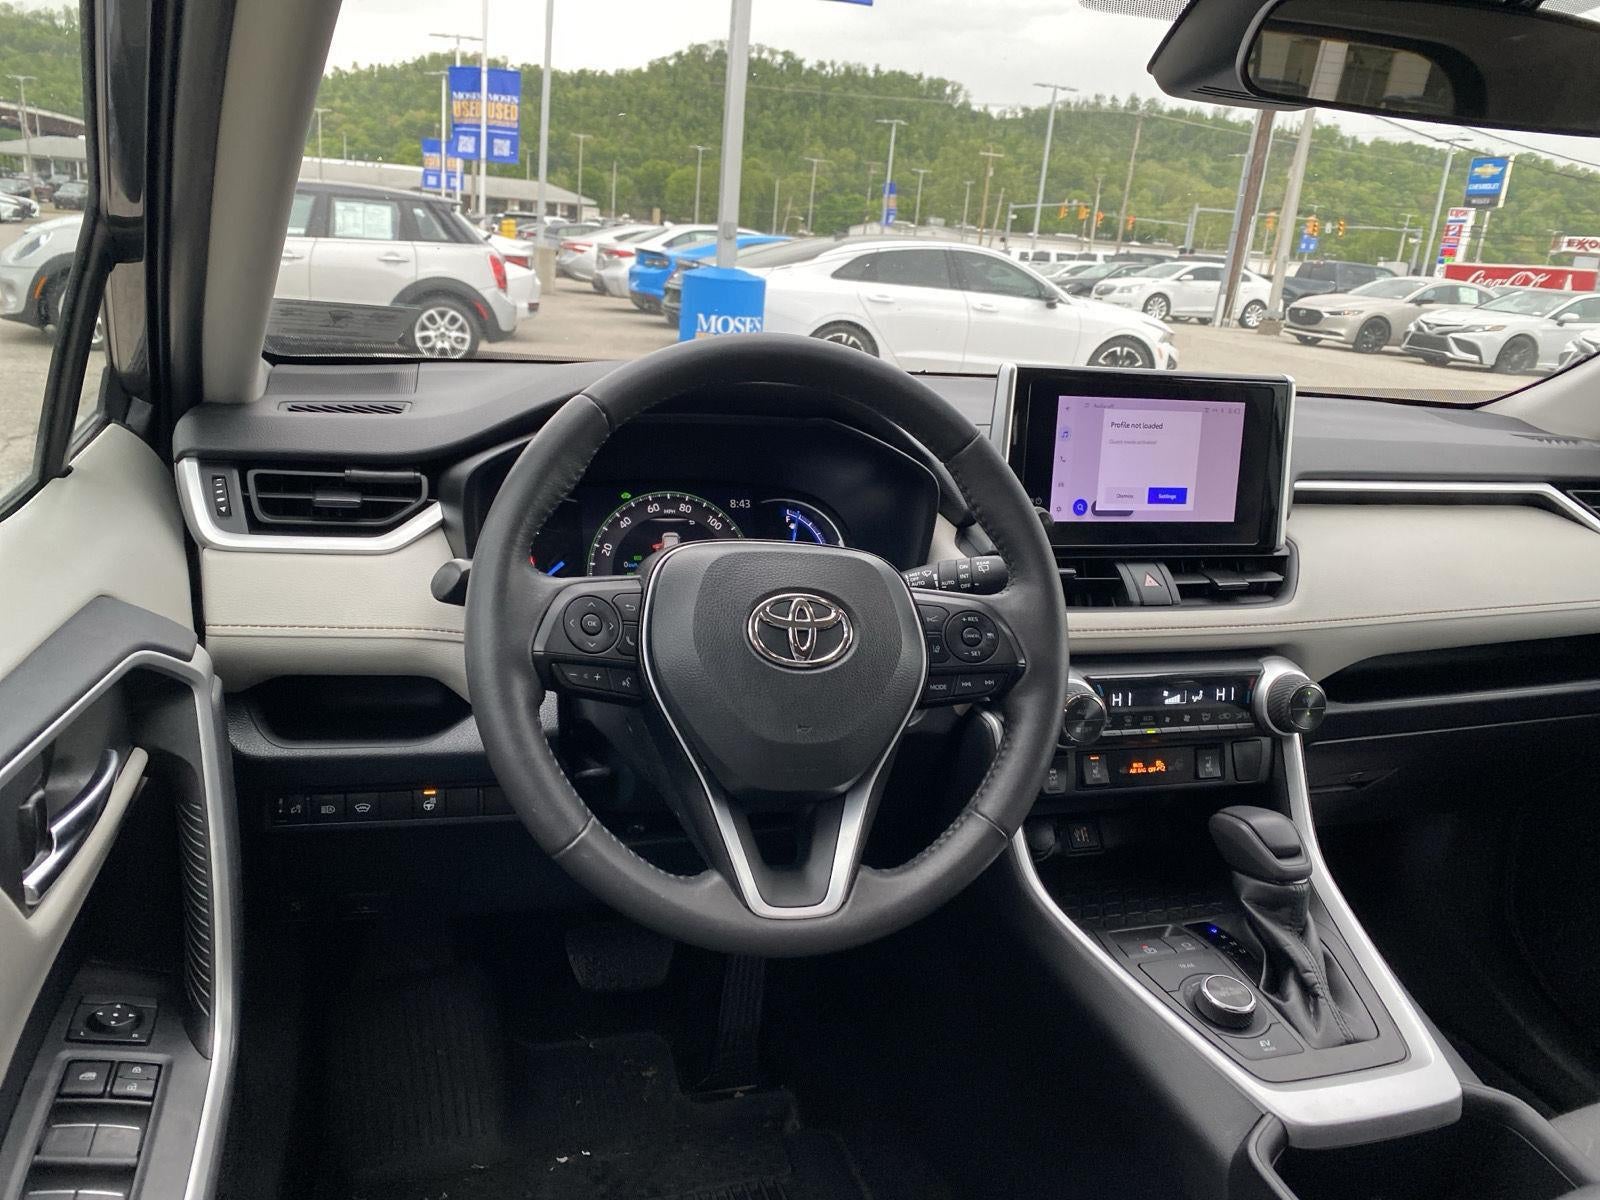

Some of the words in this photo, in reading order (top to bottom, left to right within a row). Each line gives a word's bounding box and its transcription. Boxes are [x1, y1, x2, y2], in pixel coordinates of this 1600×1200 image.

[487, 102, 518, 120] USED
[1142, 422, 1163, 430] loaded
[1158, 493, 1177, 501] Settings
[647, 502, 660, 514] 60
[679, 503, 692, 514] 80
[729, 499, 751, 509] 8:43
[619, 516, 632, 529] 40
[706, 515, 722, 531] 100
[601, 542, 613, 557] 20
[1112, 692, 1131, 706] HI
[1216, 686, 1235, 702] HI
